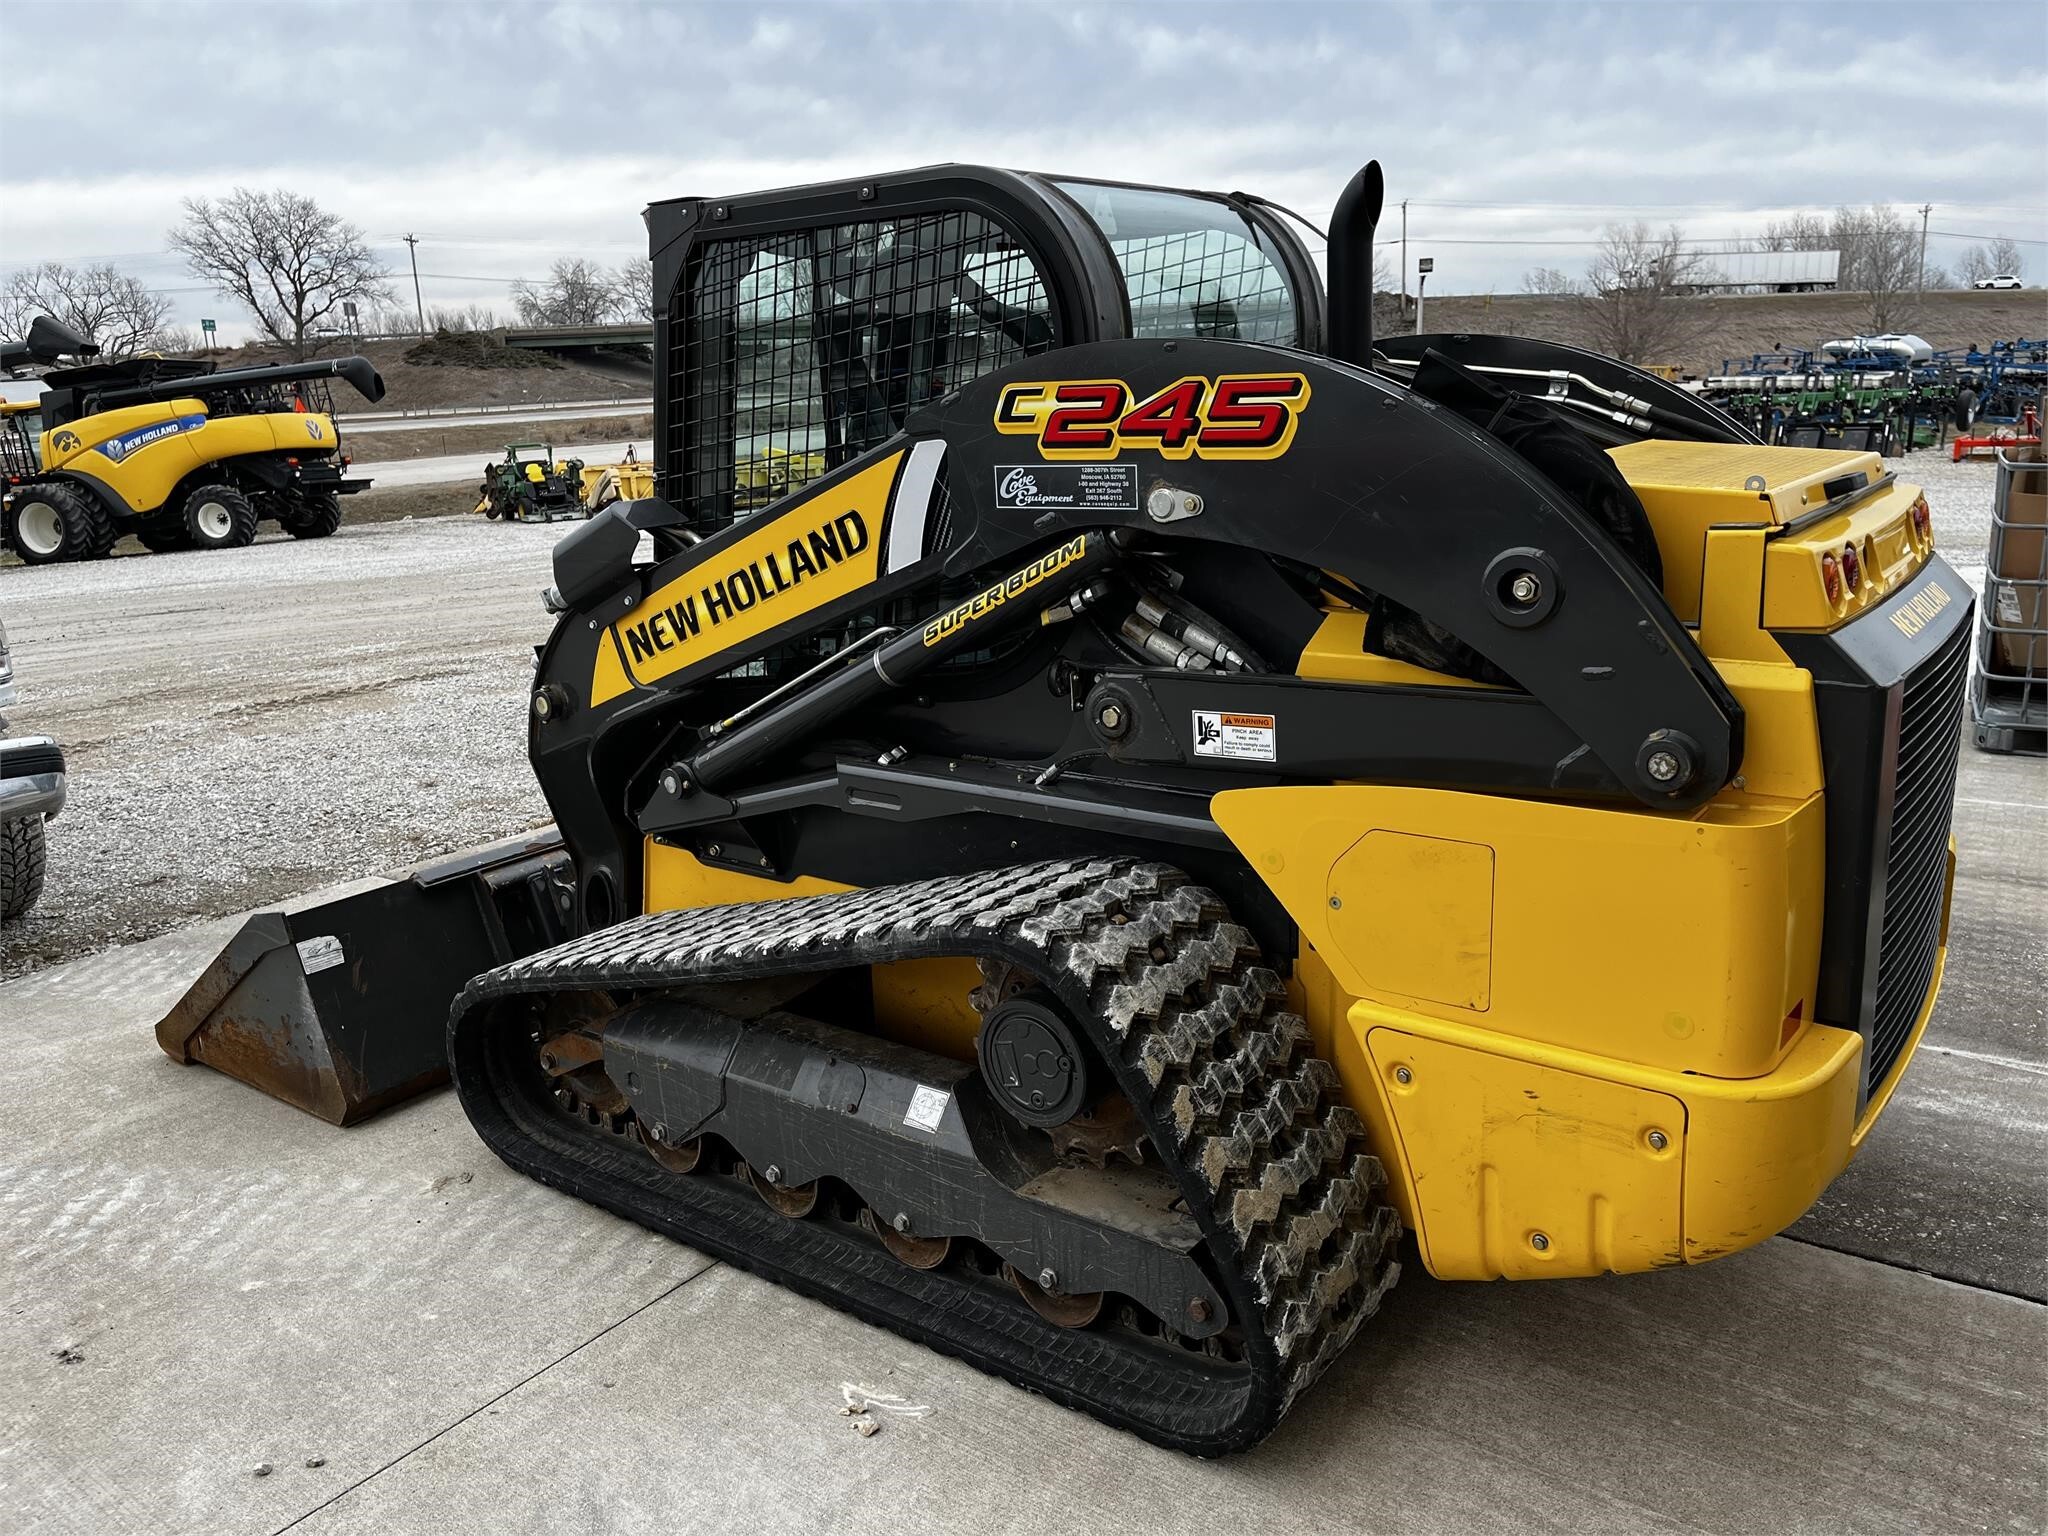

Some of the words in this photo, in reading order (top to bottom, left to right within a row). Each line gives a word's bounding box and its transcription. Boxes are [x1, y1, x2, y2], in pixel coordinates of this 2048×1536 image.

[124, 436, 141, 451] NEW
[142, 424, 178, 442] HOLLAND
[1000, 468, 1036, 498] Cove
[1015, 486, 1074, 506] Equipment
[625, 595, 701, 665] NEW
[700, 509, 870, 627] HOLLAND
[923, 582, 1006, 647] SUPER
[1006, 534, 1086, 598] BOOM
[1888, 603, 1926, 639] NEW
[1907, 581, 1952, 623] HOLLAND
[1233, 717, 1269, 726] WARNING
